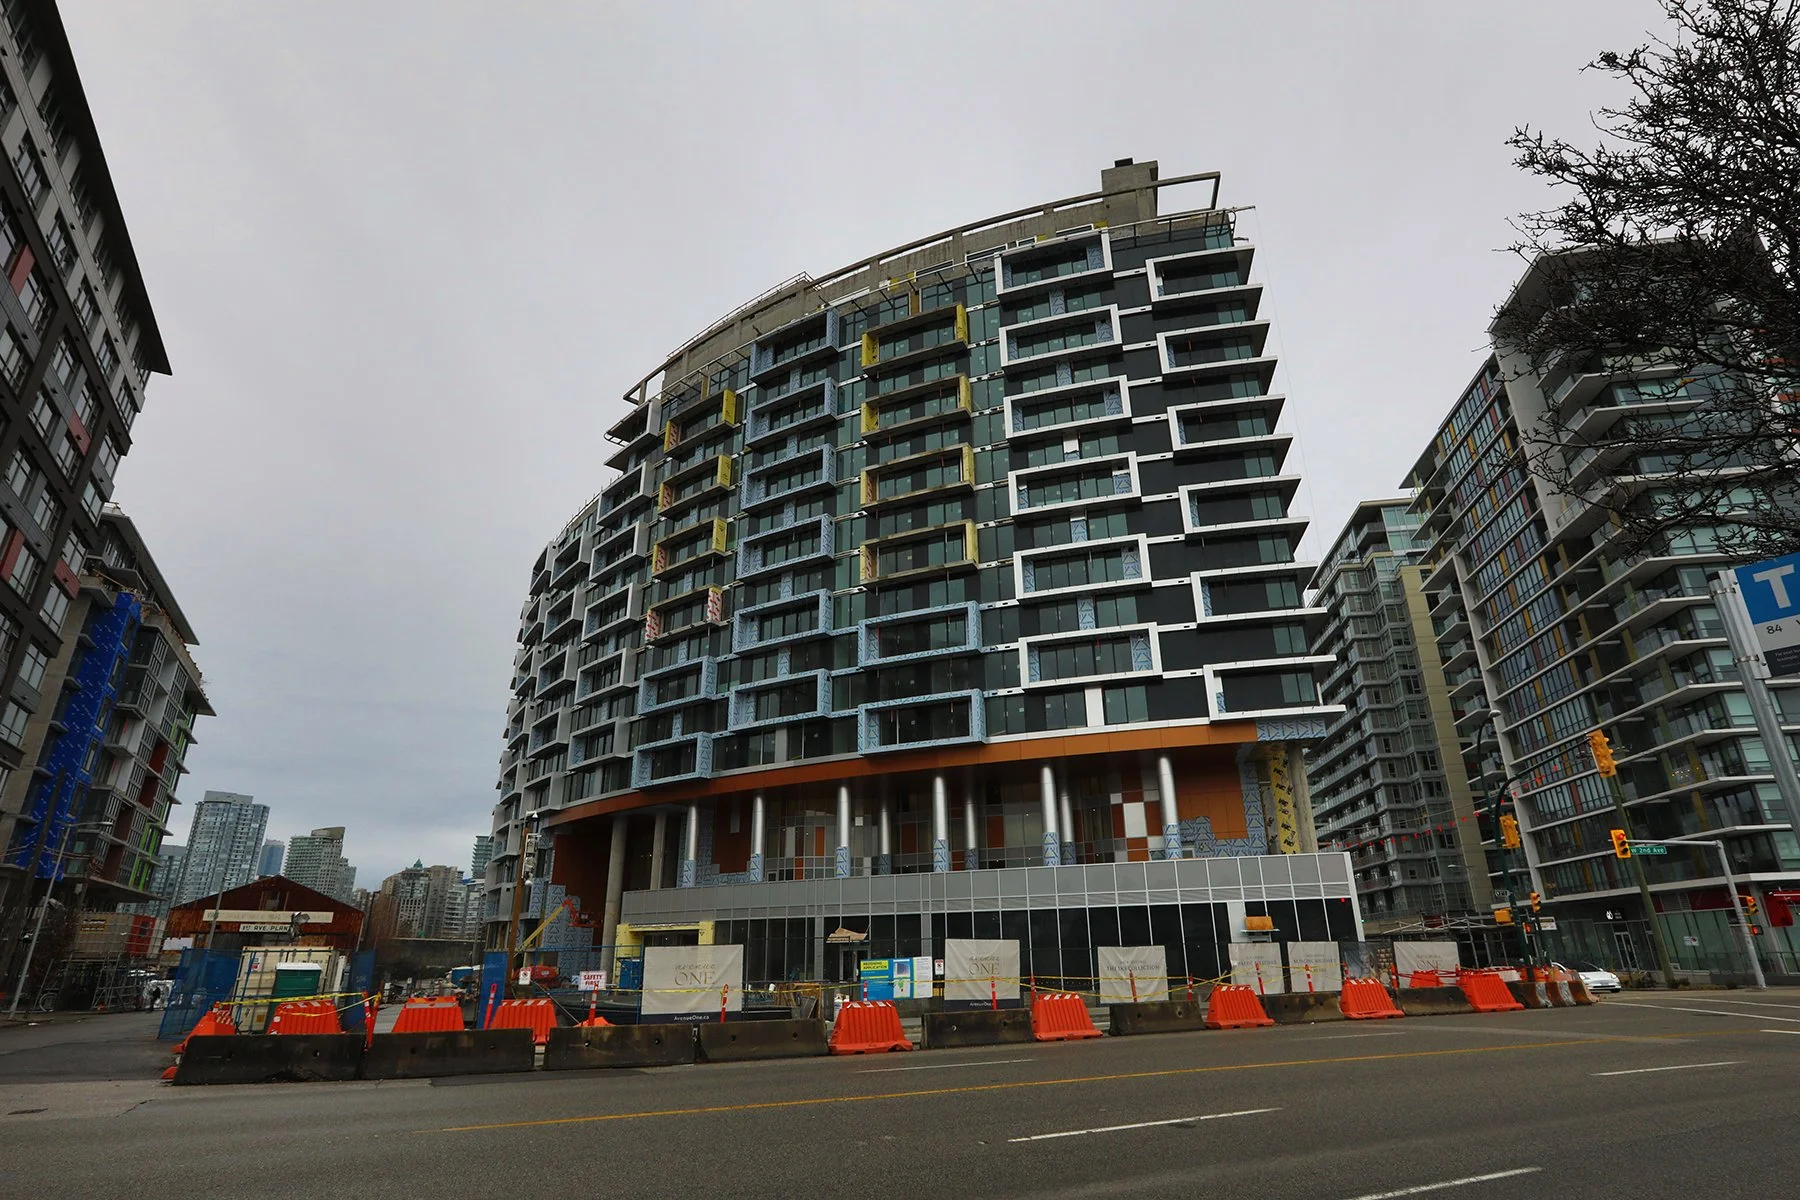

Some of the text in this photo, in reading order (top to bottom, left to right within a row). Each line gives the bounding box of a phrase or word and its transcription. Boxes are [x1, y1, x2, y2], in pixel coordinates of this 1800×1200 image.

[1753, 564, 1795, 609] T
[1767, 624, 1783, 635] 84
[969, 963, 1000, 975] ONE
[675, 971, 716, 986] ONE
